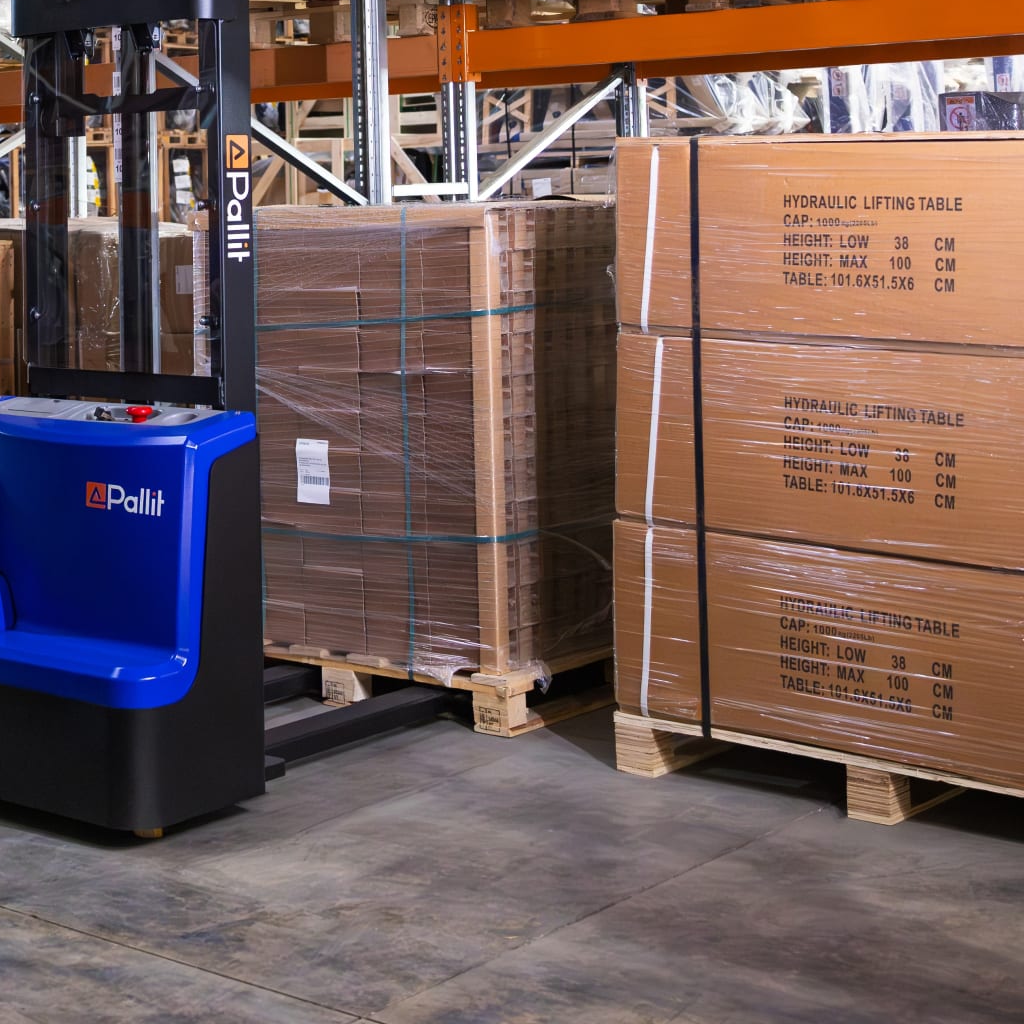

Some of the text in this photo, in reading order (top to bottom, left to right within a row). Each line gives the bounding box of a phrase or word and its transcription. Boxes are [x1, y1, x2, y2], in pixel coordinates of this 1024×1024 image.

[226, 172, 250, 262] Pallit
[783, 195, 963, 211] HYDRAULIC LIFTING TABLE
[783, 214, 813, 227] CAP:
[783, 234, 955, 252] HEIGHT: LOW 38 CM
[783, 252, 956, 272] HEIGHT: MAX 100 CM
[783, 271, 955, 292] TABLE: 101.6X51.5X6 CM
[783, 416, 814, 432] CAP:
[784, 396, 965, 427] HYDRAULIC LIFTING TABLE
[783, 435, 833, 454] HEIGHT:
[840, 441, 870, 458] LOW
[935, 452, 956, 468] CM
[783, 454, 957, 489] HEIGHT: MAX 100 CM
[107, 483, 165, 517] Pallit
[783, 474, 955, 510] TABLE: 101.6X51.5X6 CM
[780, 595, 960, 639] HYDRAULIC LIFTING TABLE
[780, 616, 810, 634] CAP:
[780, 635, 952, 679] HEIGHT: LOW 38 CM
[780, 656, 953, 700] HEIGHT: MAX 100 CM
[780, 674, 825, 697] TABLE:
[932, 704, 953, 721] CM
